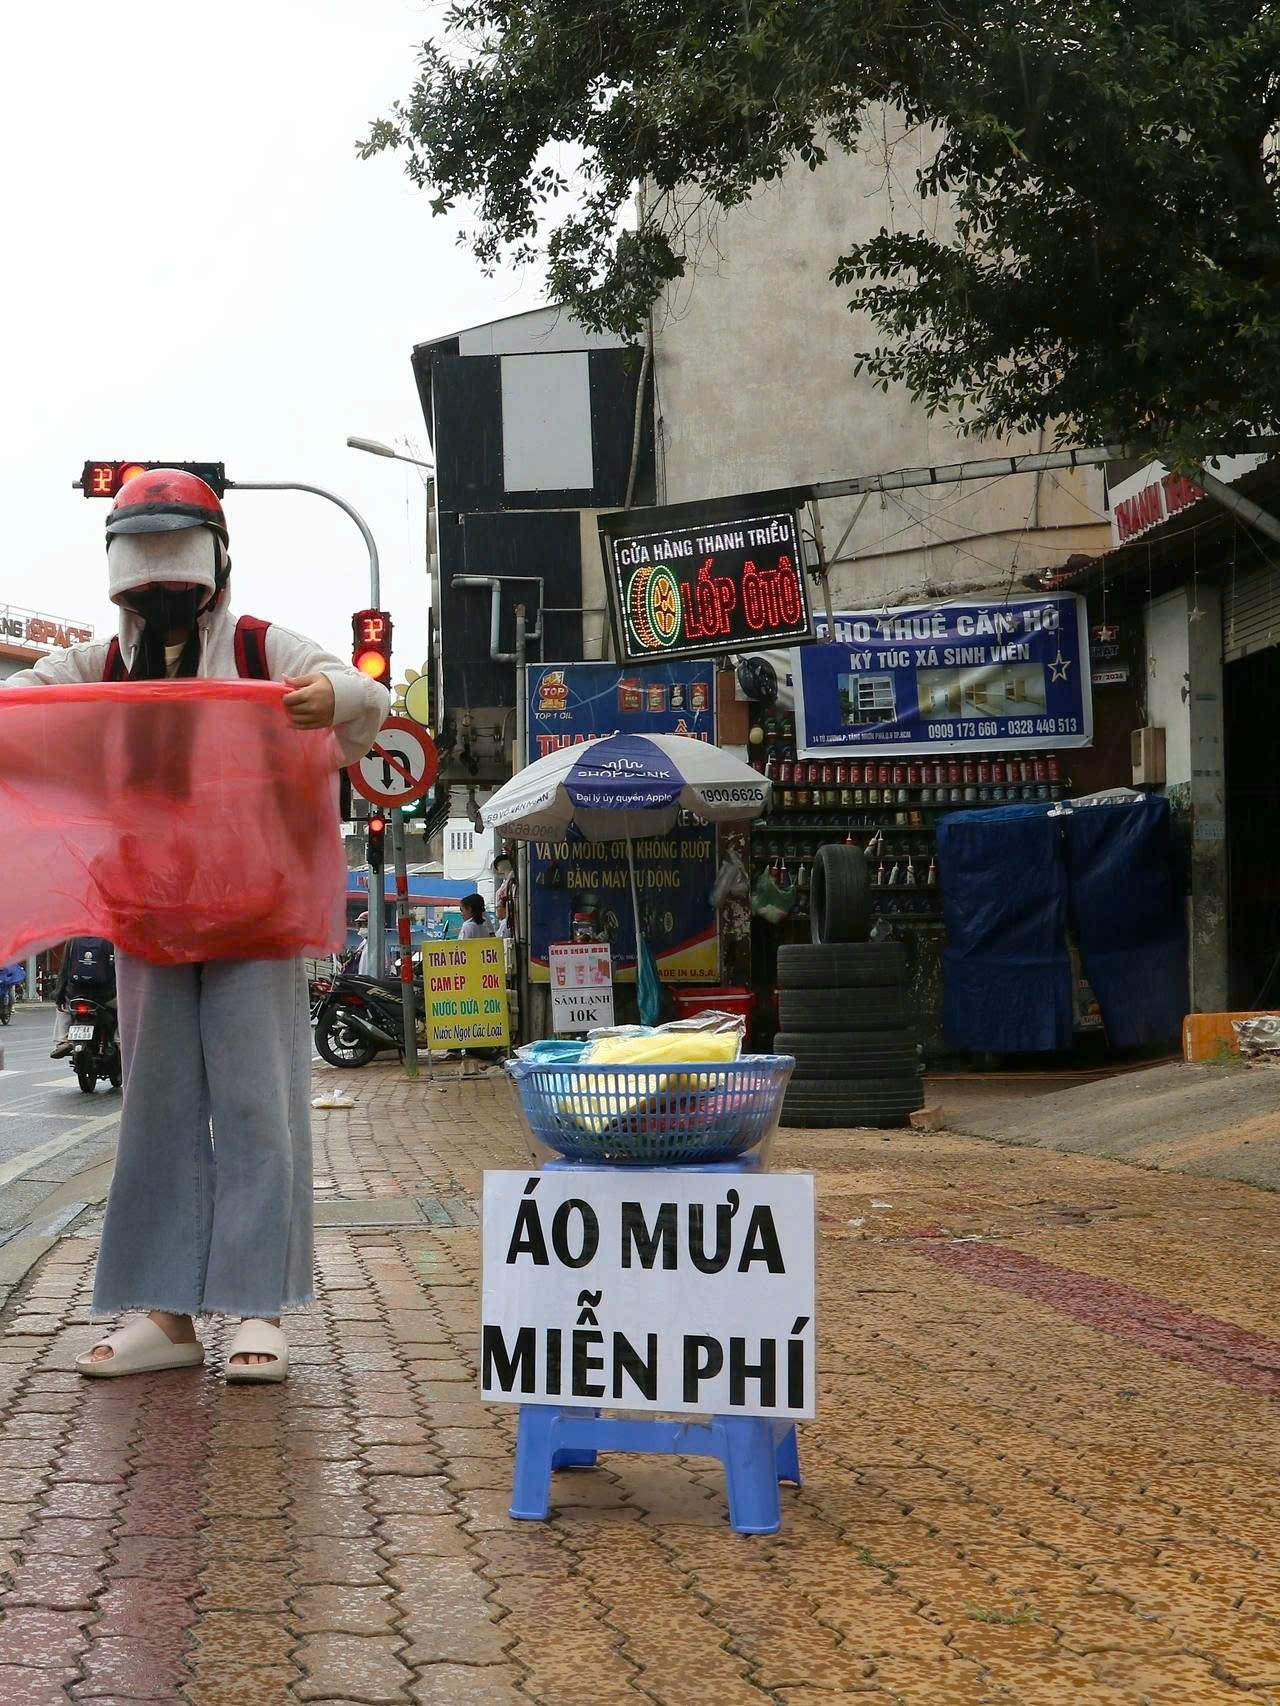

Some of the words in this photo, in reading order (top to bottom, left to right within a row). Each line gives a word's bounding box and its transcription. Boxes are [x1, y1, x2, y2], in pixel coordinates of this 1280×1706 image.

[93, 468, 113, 491] 32
[621, 541, 651, 565] CỬA
[653, 538, 693, 561] HÀNG
[696, 530, 745, 551] THANH
[748, 520, 790, 546] TRIỀU
[681, 558, 737, 638] LỐP
[364, 618, 383, 642] 32
[880, 613, 948, 641] THUÊ
[956, 609, 1015, 637] CĂN
[1023, 604, 1060, 635] HỘ
[850, 649, 873, 670] KÝ
[877, 648, 910, 669] TÚC
[915, 645, 939, 667] XÁ
[943, 647, 985, 665] SINH
[990, 642, 1029, 662] VIÊN
[542, 686, 566, 696] TOP
[535, 712, 550, 720] TOP
[560, 711, 573, 720] OIL
[928, 723, 954, 739] 0909
[956, 722, 975, 738] 173
[978, 721, 998, 737] 660
[1008, 719, 1034, 735] 0328
[1036, 719, 1056, 735] 449
[1058, 717, 1077, 734] 513
[576, 793, 591, 803] Đại
[593, 793, 601, 803] lý
[646, 793, 673, 803] Apple
[700, 788, 764, 802] 1900.6626
[647, 865, 681, 893] ĐỘNG
[429, 948, 447, 967] TRÀ
[481, 948, 498, 964] 15k
[430, 976, 452, 992] CAM
[454, 973, 466, 991] ÉP
[482, 974, 500, 989] 20k
[659, 969, 676, 977] ADE
[678, 969, 687, 977] IN
[432, 999, 457, 1016] NƯỚC
[460, 998, 480, 1015] DỪA
[484, 999, 501, 1014] 20k
[554, 994, 578, 1006] SÂM
[581, 994, 611, 1007] LẠNH
[570, 1009, 598, 1022] 10K
[454, 1023, 471, 1041] Ngọt
[472, 1023, 486, 1038] Các
[487, 1022, 503, 1040] Loại
[506, 1177, 600, 1269] ÁO
[621, 1188, 786, 1274] MƯA
[482, 1289, 658, 1402] MIỄN
[682, 1316, 811, 1409] PHÍ
